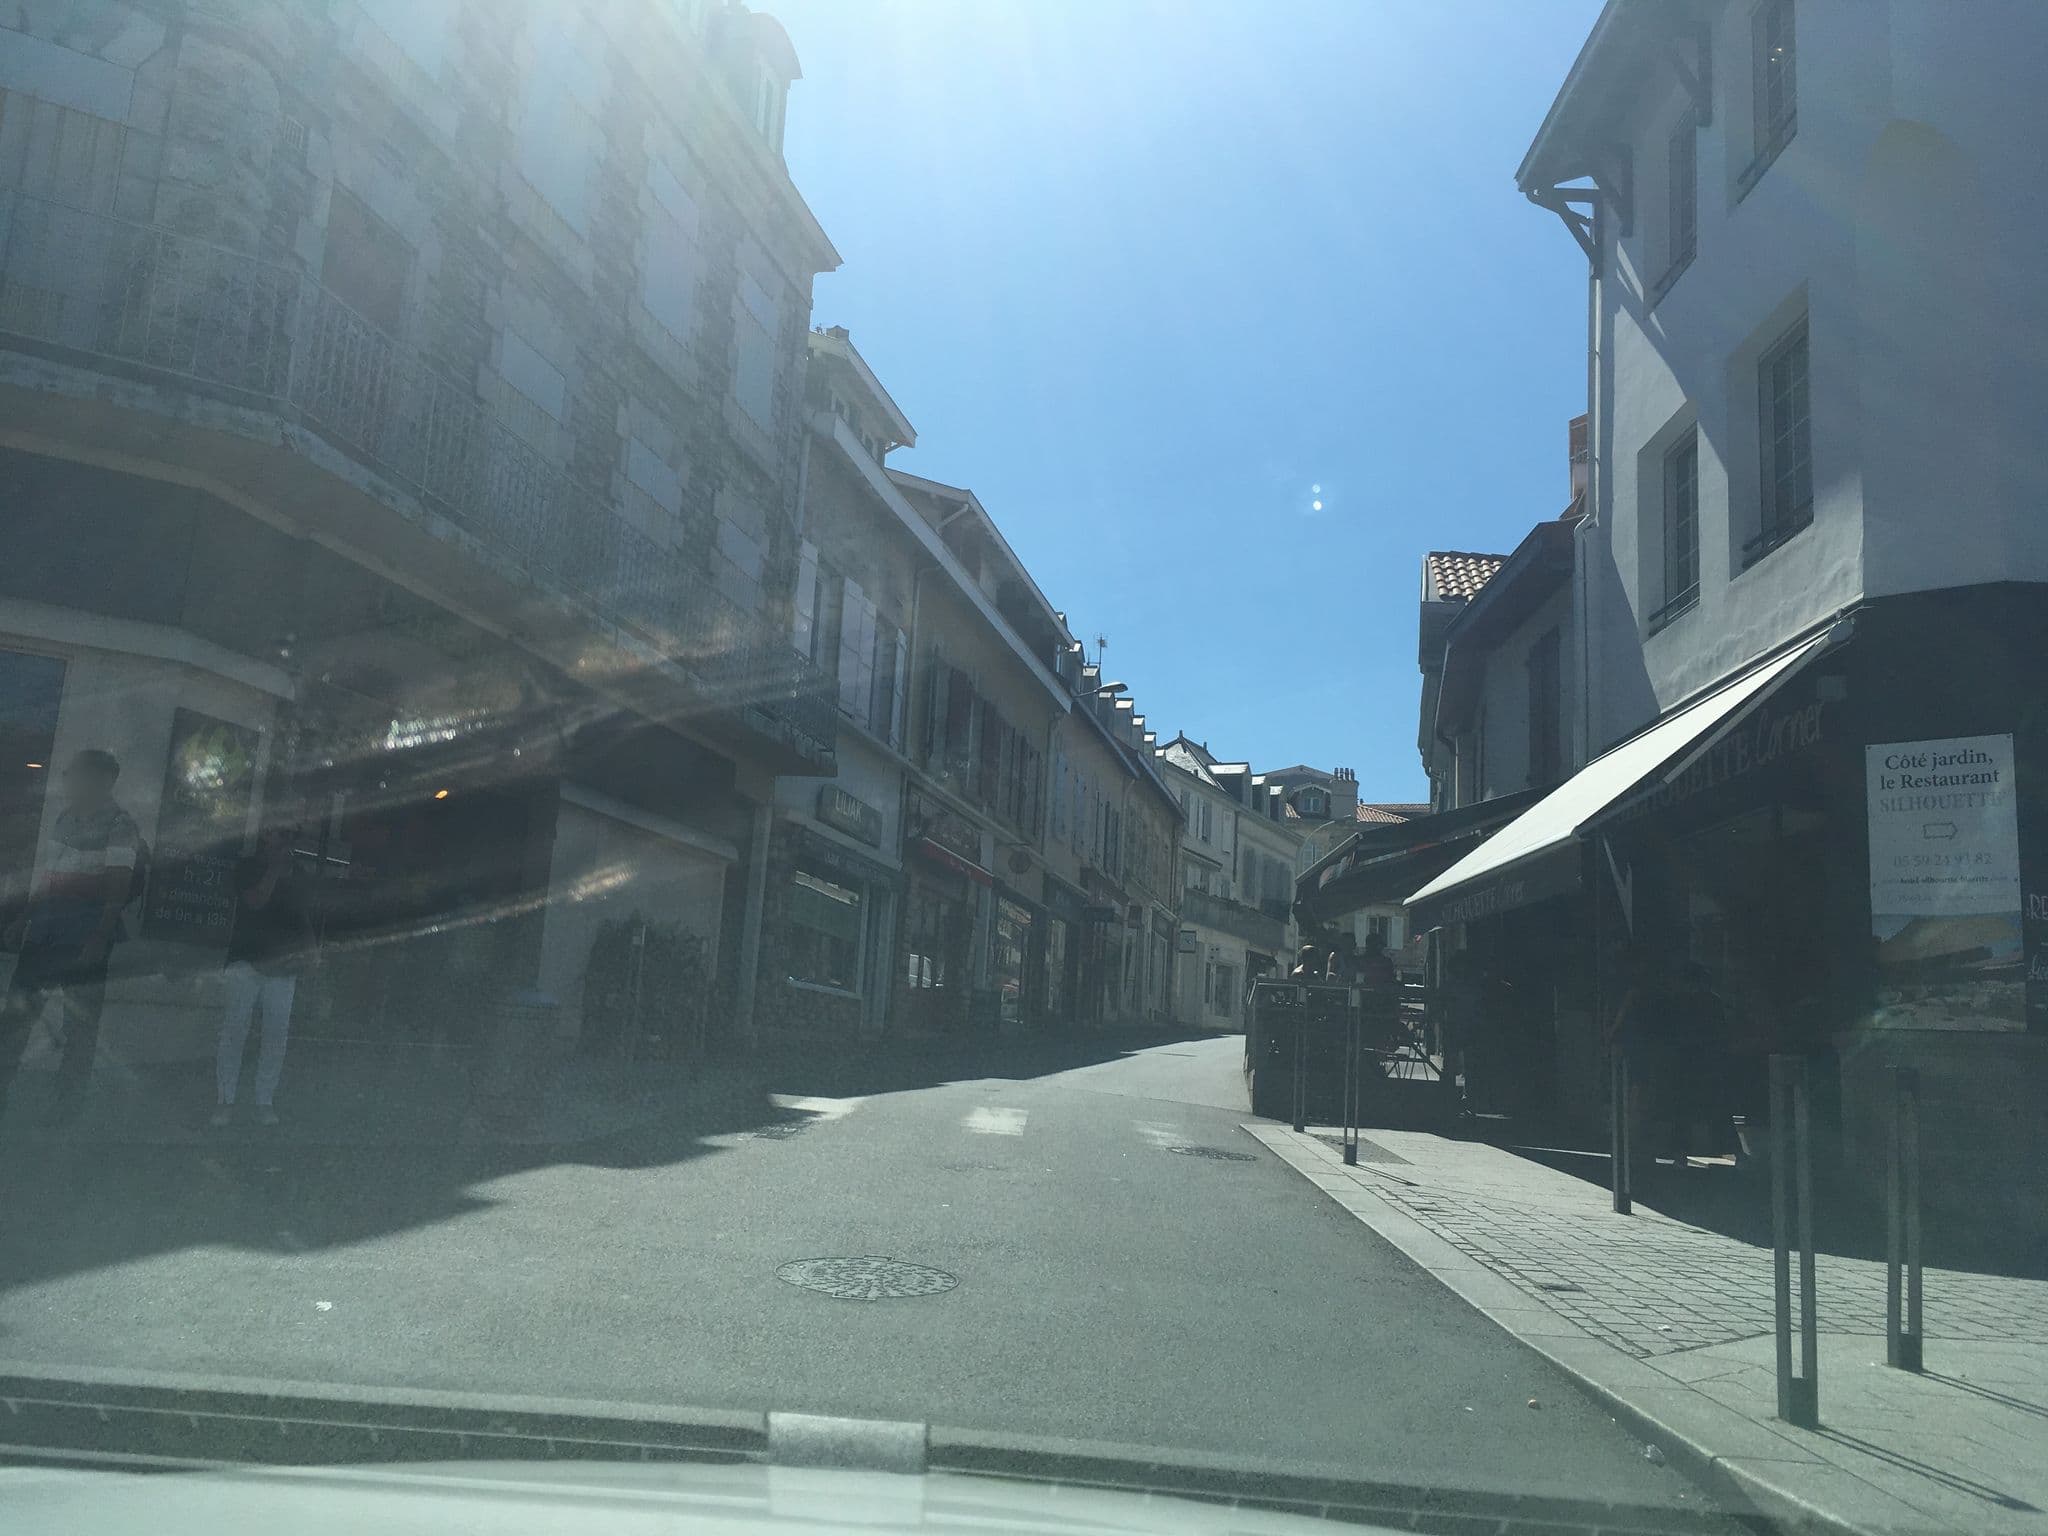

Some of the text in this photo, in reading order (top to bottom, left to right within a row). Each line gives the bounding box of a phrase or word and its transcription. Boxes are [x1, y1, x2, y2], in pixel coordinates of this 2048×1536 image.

[1885, 749, 1994, 771] Côté jardin,
[1880, 769, 2001, 790] le Restaurant
